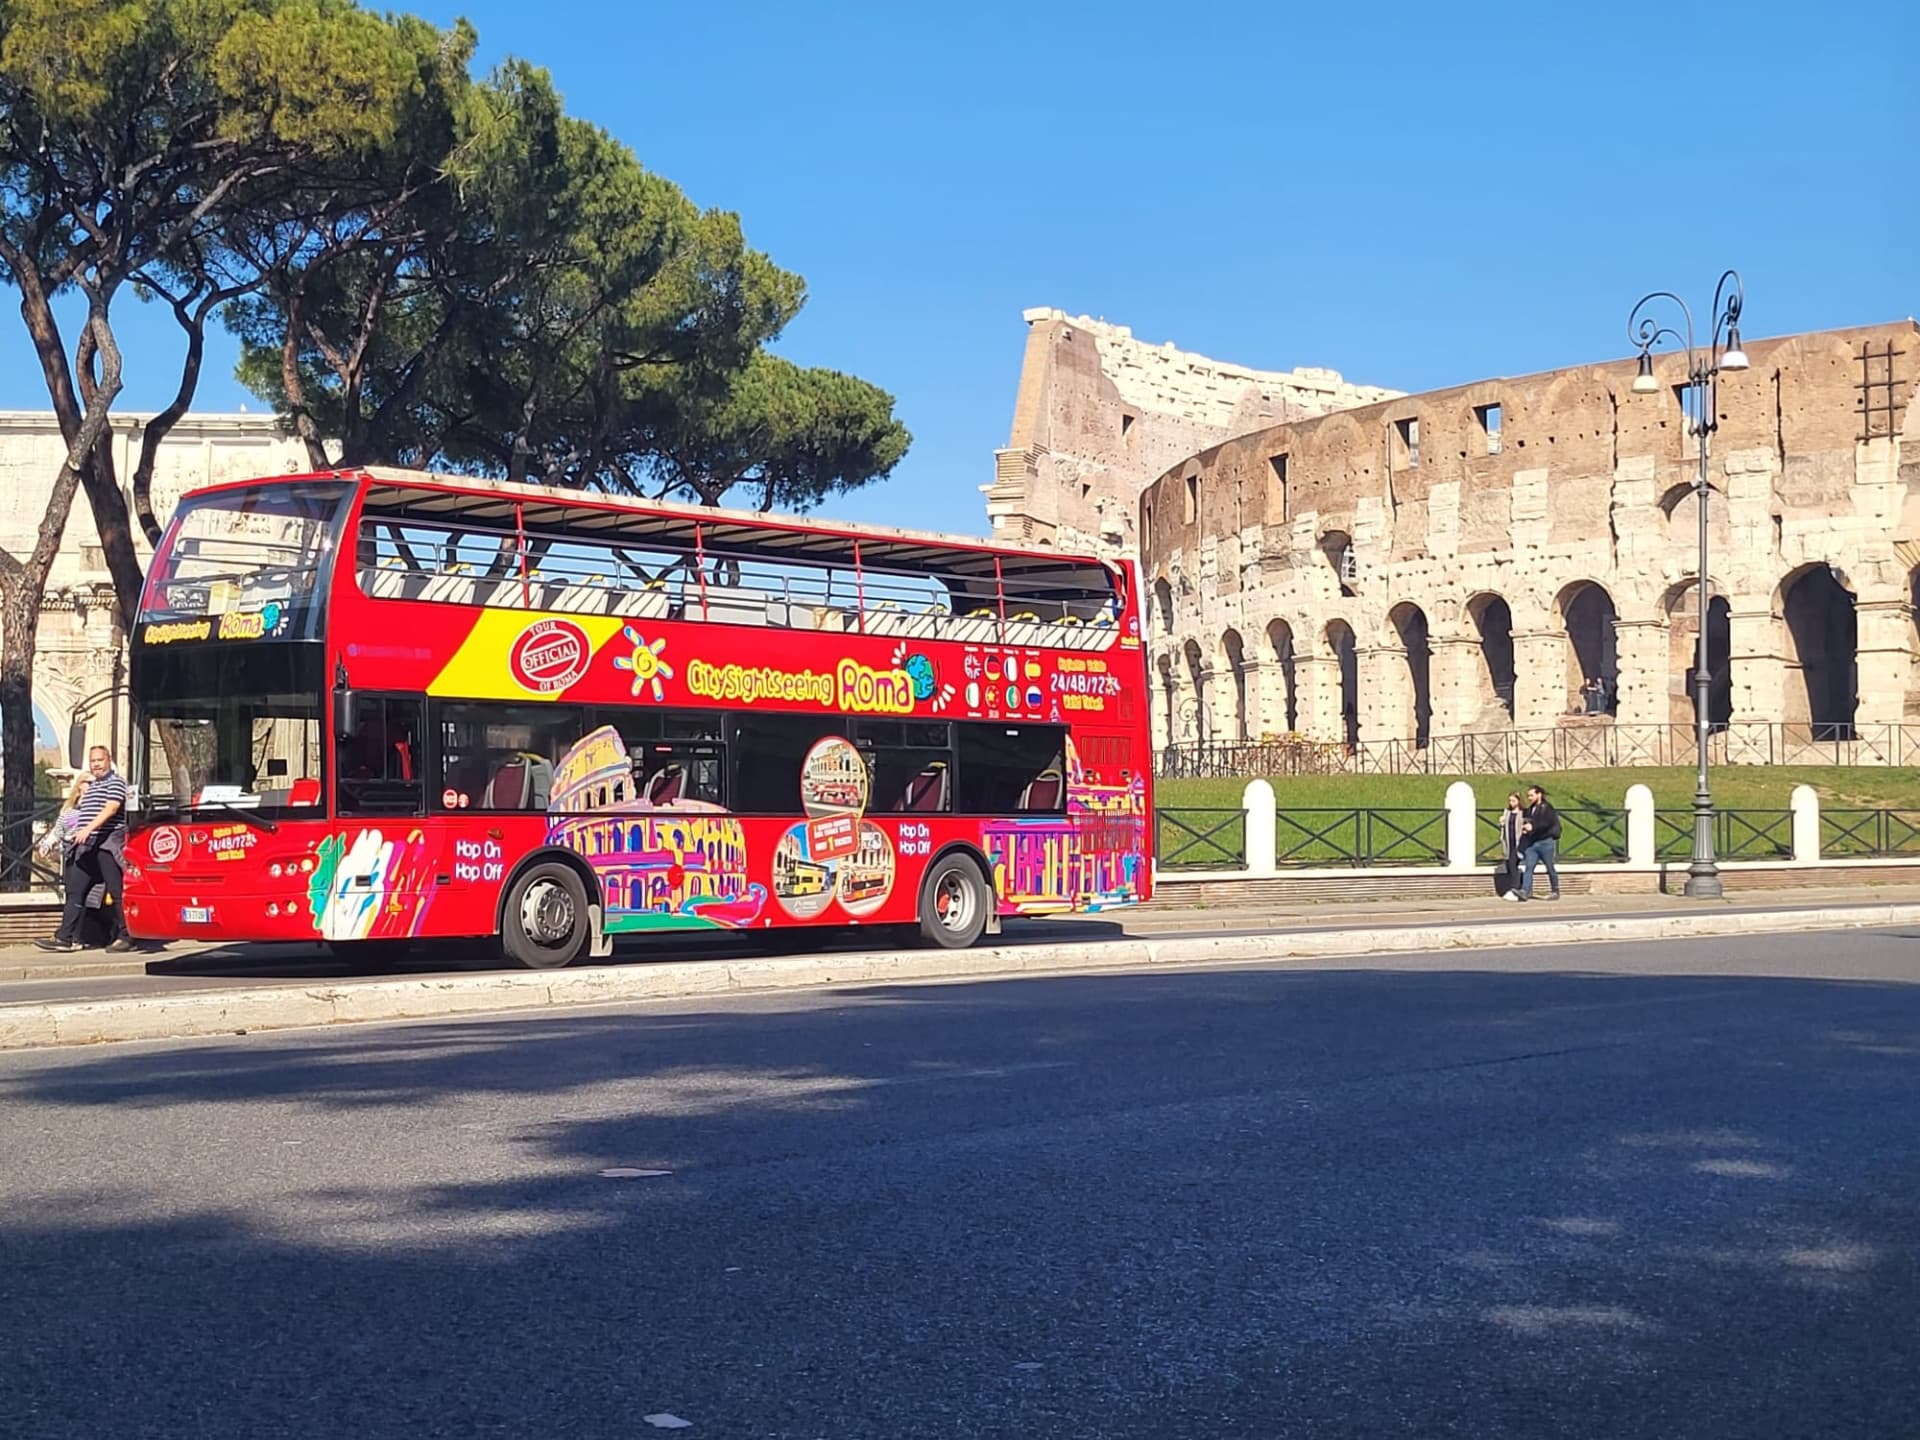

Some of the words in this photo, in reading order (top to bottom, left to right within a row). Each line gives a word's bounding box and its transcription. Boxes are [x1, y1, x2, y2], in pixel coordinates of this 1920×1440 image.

[529, 621, 557, 637] TOUR
[523, 642, 577, 669] OFFICIAL
[539, 681, 552, 691] OF
[552, 670, 579, 690] ROMA
[688, 659, 833, 706] CitySightseeing
[837, 658, 915, 713] Roma
[899, 823, 917, 839] Hop
[917, 823, 930, 837] On
[456, 840, 481, 860] Hop
[484, 840, 501, 858] On
[899, 840, 917, 856] Hop
[917, 840, 931, 854] Off
[455, 862, 481, 882] Hop
[483, 862, 503, 880] Off
